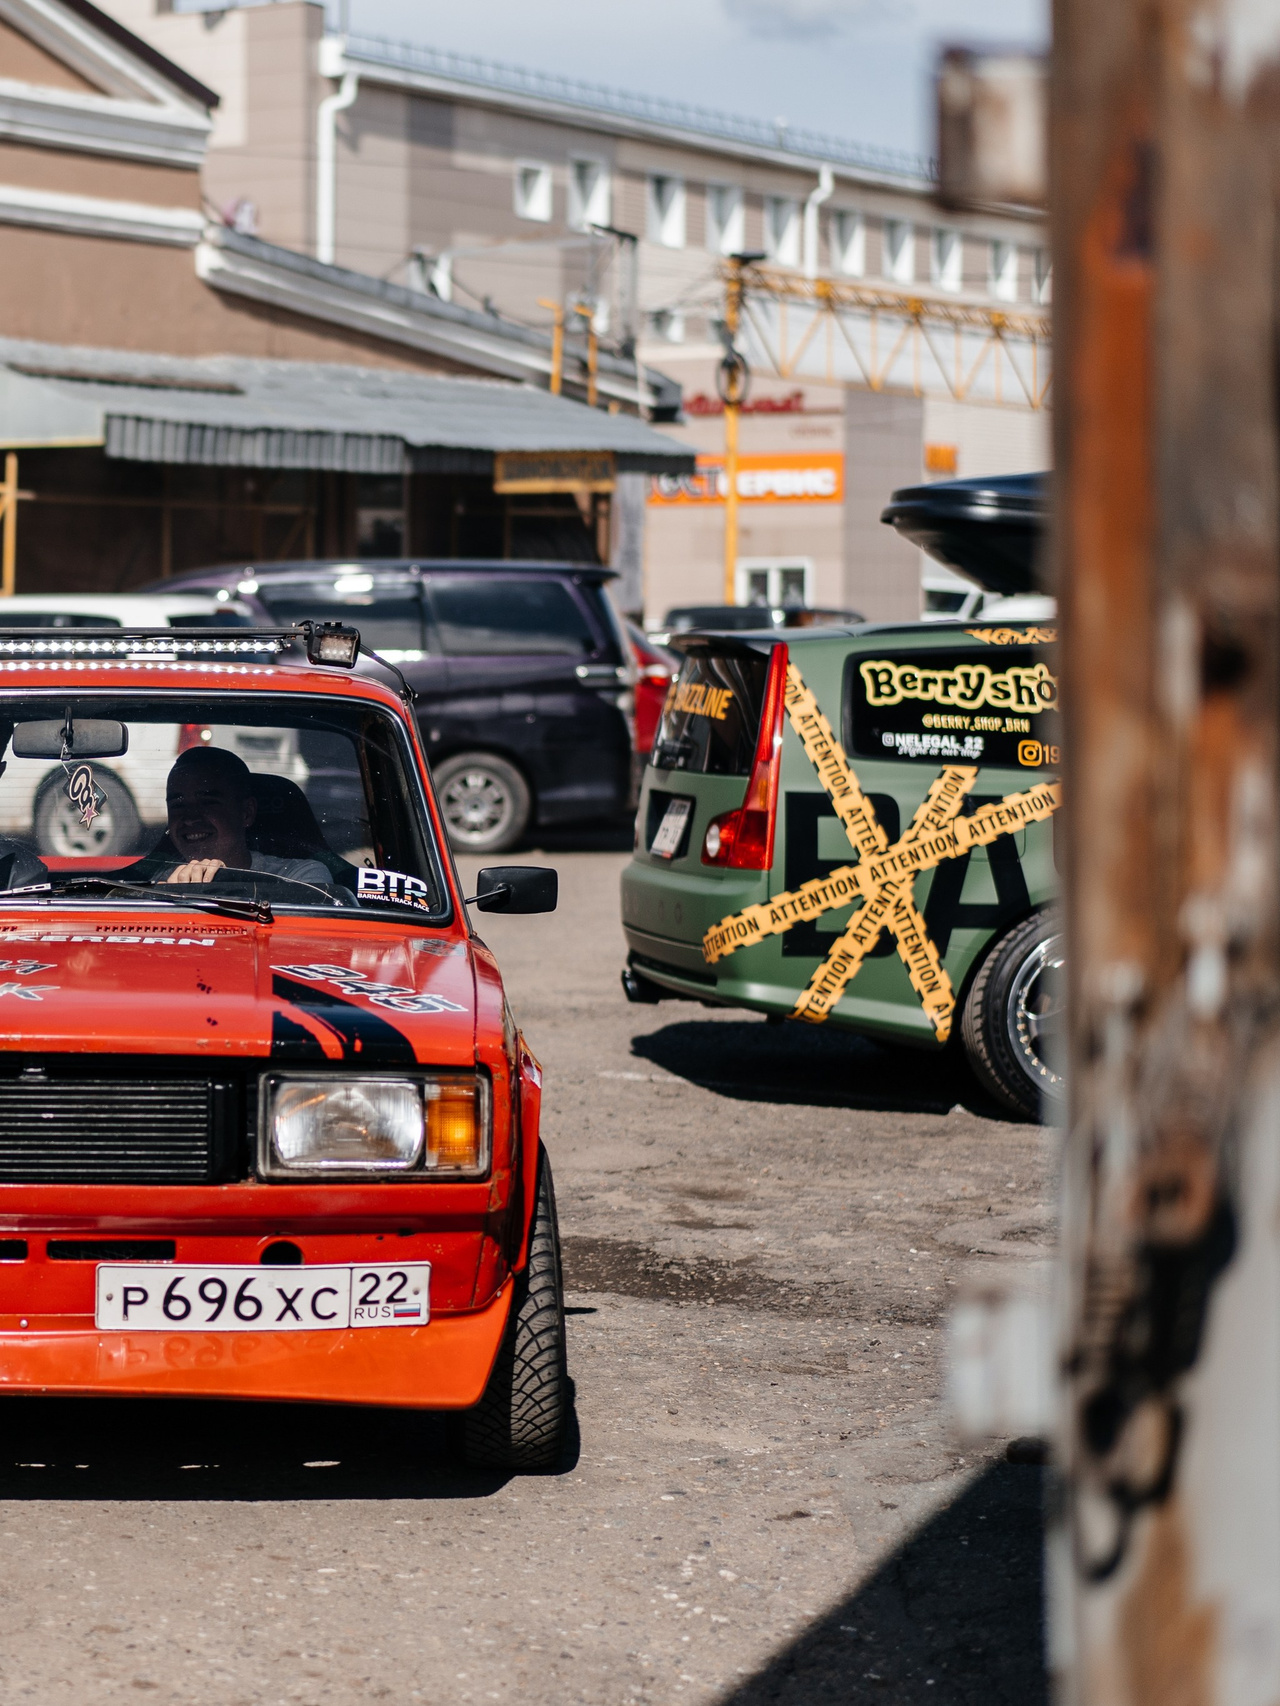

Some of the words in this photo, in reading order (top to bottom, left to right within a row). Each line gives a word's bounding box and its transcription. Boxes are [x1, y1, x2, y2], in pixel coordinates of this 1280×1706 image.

[860, 661, 1059, 713] Berrysho
[798, 713, 854, 799] ATTENTION
[846, 808, 880, 857] ATTEN
[968, 791, 1056, 839] ATTENTION
[870, 832, 959, 882] ATTENTION
[357, 867, 429, 907] BTR
[357, 892, 391, 902] BARNAUL
[391, 896, 413, 907] TRACK
[413, 902, 430, 913] RACE
[770, 873, 861, 925] ATTENTION
[354, 1305, 391, 1320] RUS
[358, 1271, 409, 1306] 22
